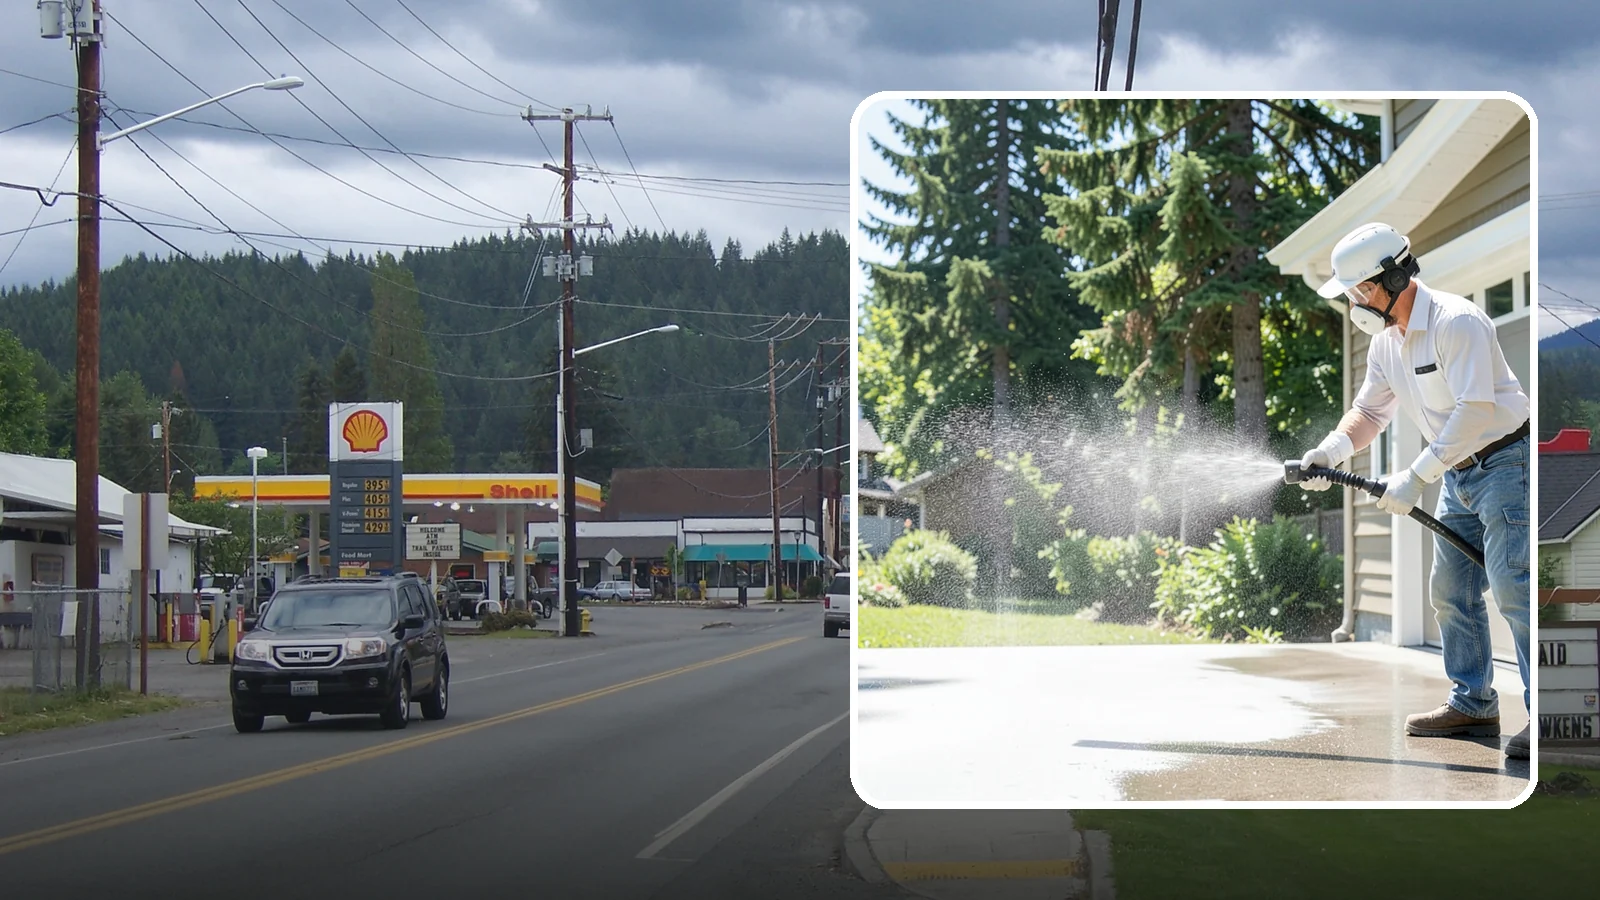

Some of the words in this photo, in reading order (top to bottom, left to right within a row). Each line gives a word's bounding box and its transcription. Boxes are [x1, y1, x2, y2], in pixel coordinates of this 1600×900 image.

[366, 480, 384, 490] 395
[490, 484, 547, 498] Shell
[365, 494, 384, 504] 405
[365, 508, 383, 518] 415
[365, 522, 384, 532] 429
